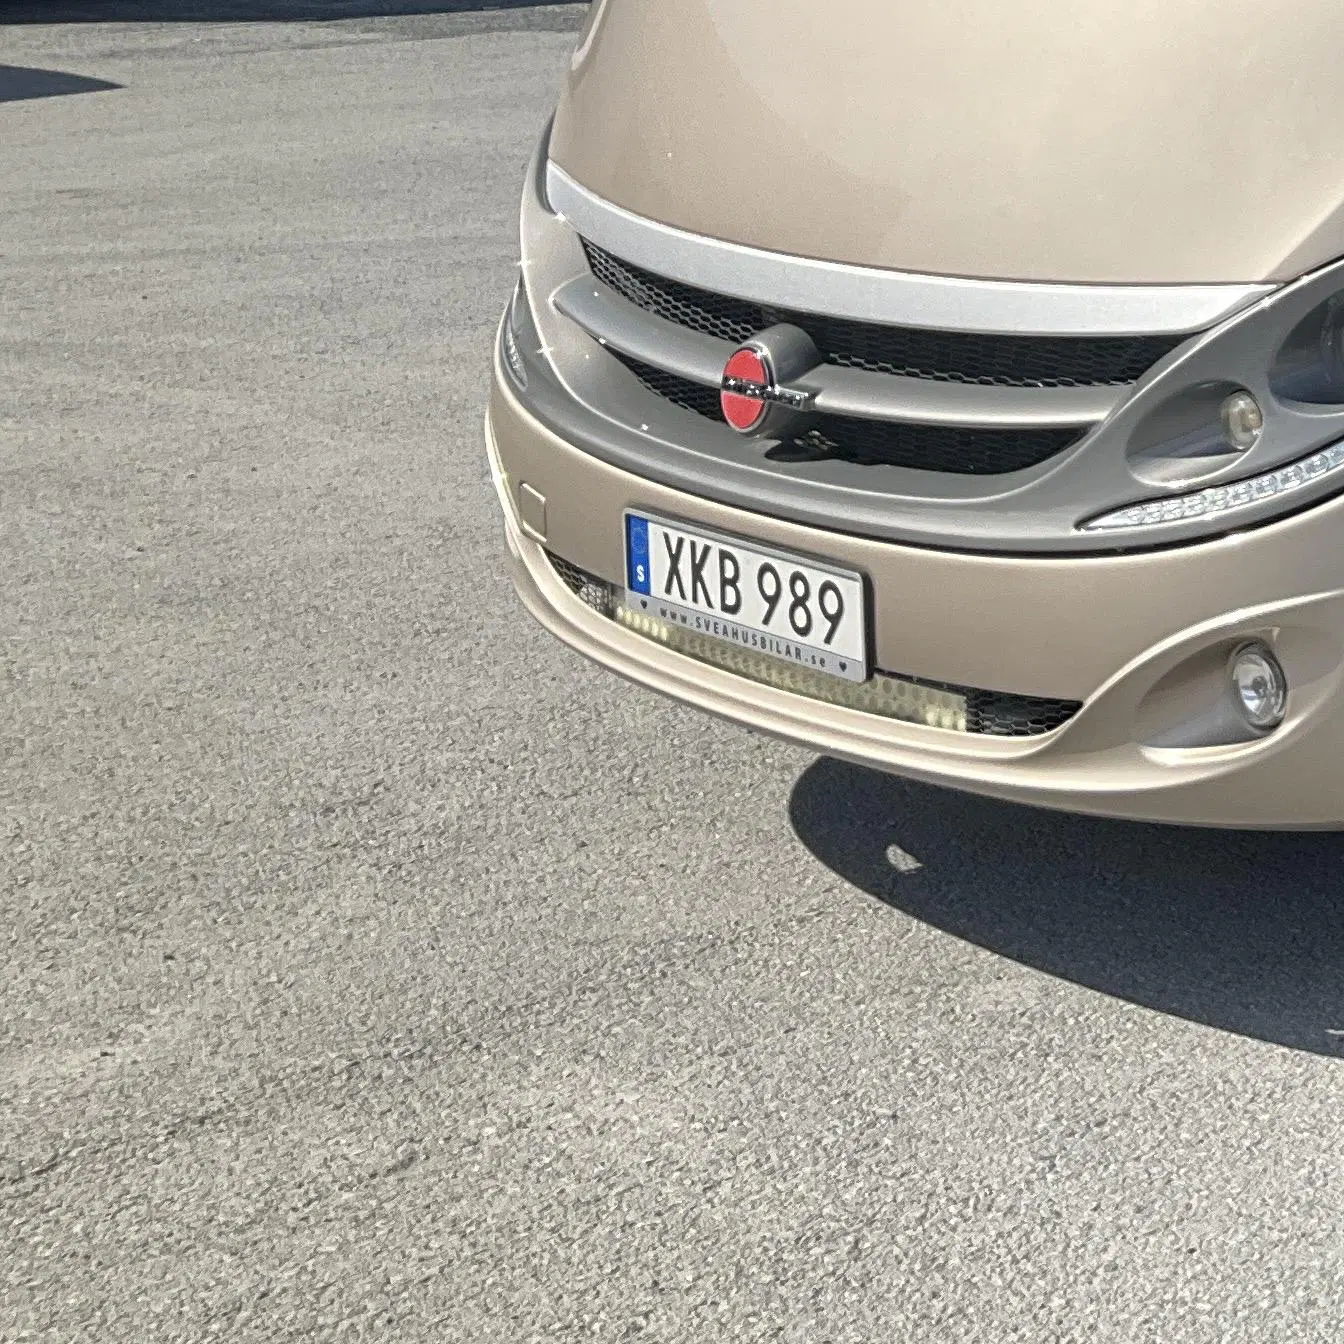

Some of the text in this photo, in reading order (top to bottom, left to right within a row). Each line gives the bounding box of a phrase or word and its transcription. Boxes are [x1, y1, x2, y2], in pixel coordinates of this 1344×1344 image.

[636, 564, 645, 582] S
[663, 531, 844, 645] XKB 989
[660, 607, 826, 667] www.SVEAHUSBILAR.se
